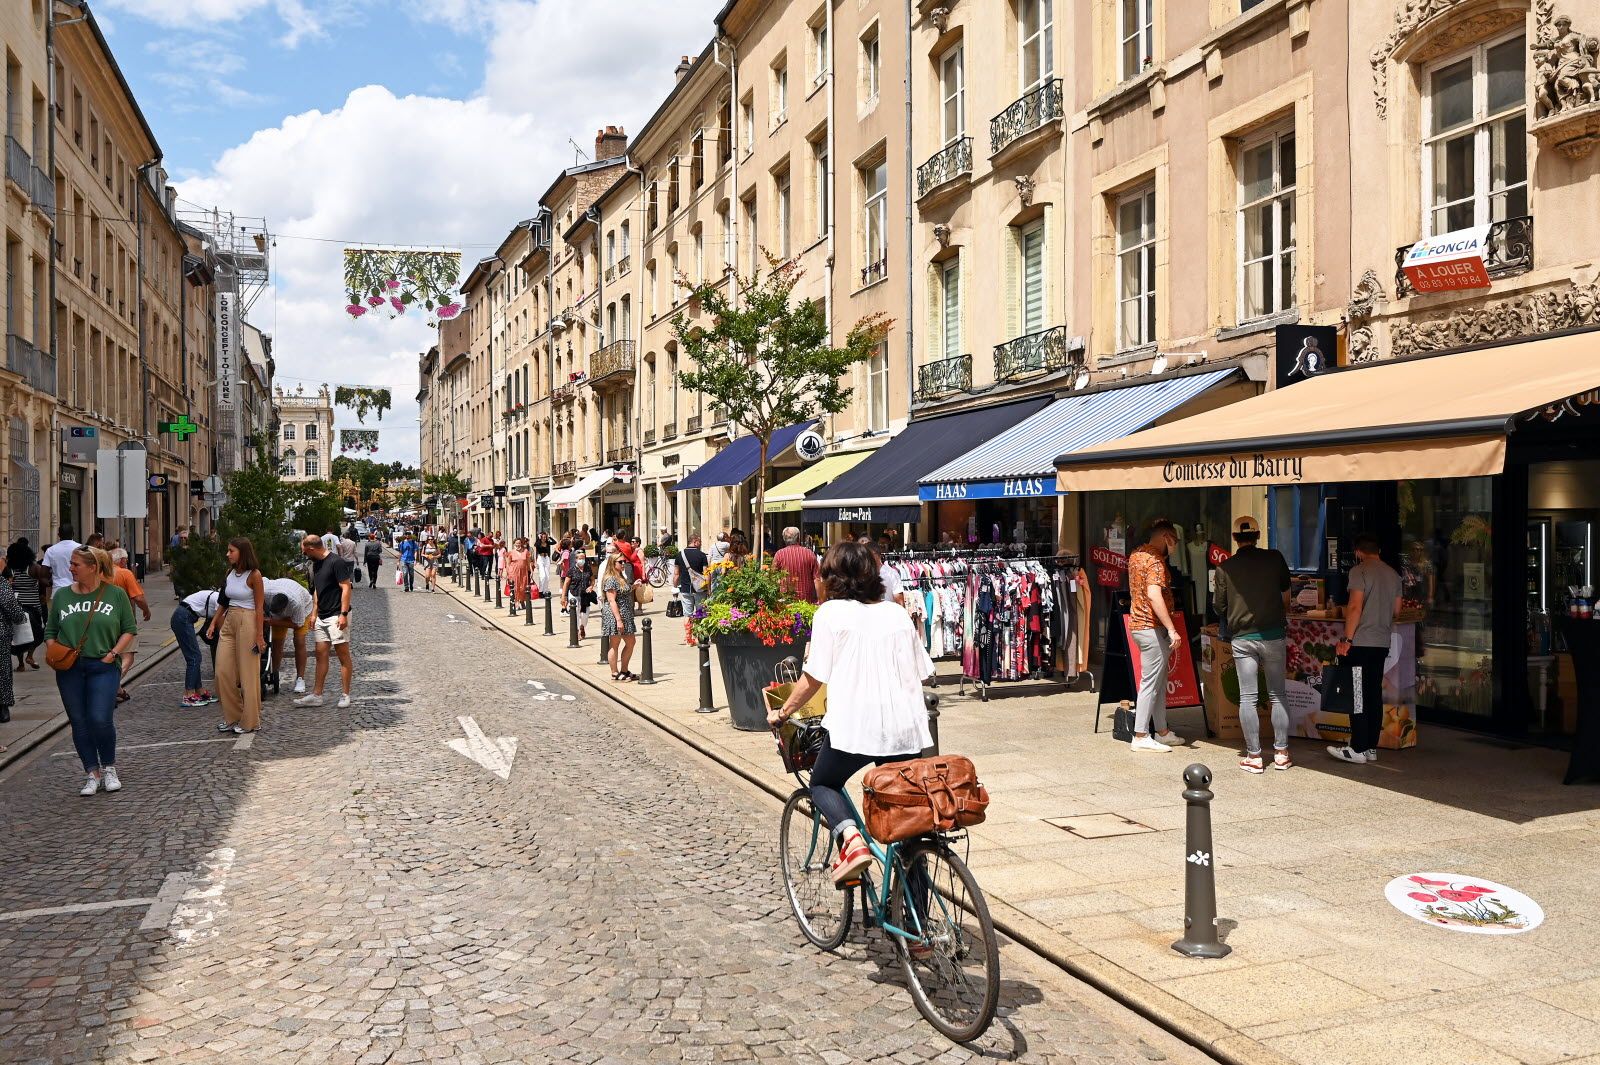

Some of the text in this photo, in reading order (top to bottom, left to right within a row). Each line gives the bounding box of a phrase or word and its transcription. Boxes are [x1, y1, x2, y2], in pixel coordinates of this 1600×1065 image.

[1428, 239, 1478, 256] FONCIA
[1416, 263, 1475, 279] À LOUER
[1420, 275, 1482, 289] 03 83 19 19 84
[220, 294, 229, 312] LOR
[220, 313, 229, 356] CONCEPT
[221, 357, 230, 399] TOITURE
[1163, 453, 1303, 482] Comtesse du Barry
[61, 471, 77, 484] GEOX
[935, 477, 1043, 499] HAAS HAAS
[838, 507, 872, 521] Eden Park
[1099, 570, 1119, 582] -50%
[60, 600, 114, 621] AMOUR
